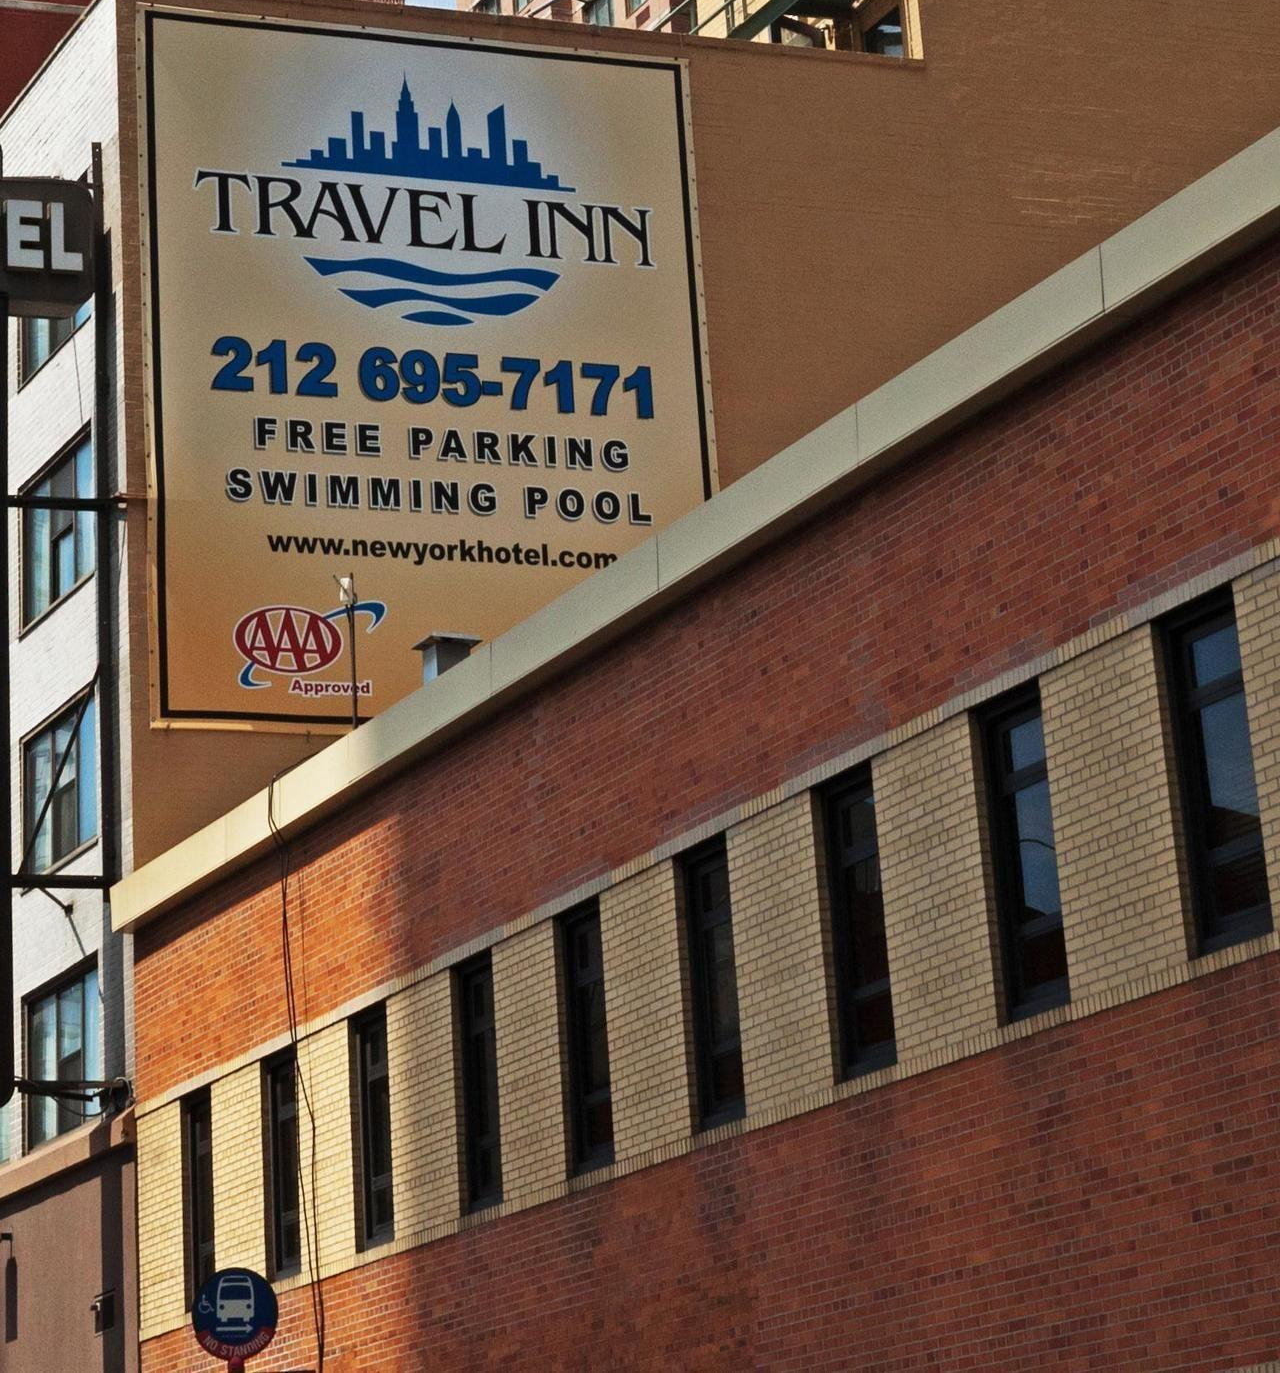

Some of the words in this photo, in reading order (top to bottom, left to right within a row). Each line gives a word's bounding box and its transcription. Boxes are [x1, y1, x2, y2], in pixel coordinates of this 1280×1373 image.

[194, 168, 508, 255] TRAVEL
[521, 198, 656, 267] INN
[210, 335, 339, 398] 212
[357, 345, 655, 419] 695-7171
[253, 416, 382, 455] FREE
[408, 426, 631, 471] PARKING
[226, 467, 498, 514] SWIMMING
[523, 485, 653, 525] POOL
[267, 533, 618, 569] www.newyorkhotel.com
[242, 607, 336, 673] AAA
[202, 1335, 219, 1350] NO
[221, 1331, 270, 1357] STANDING
